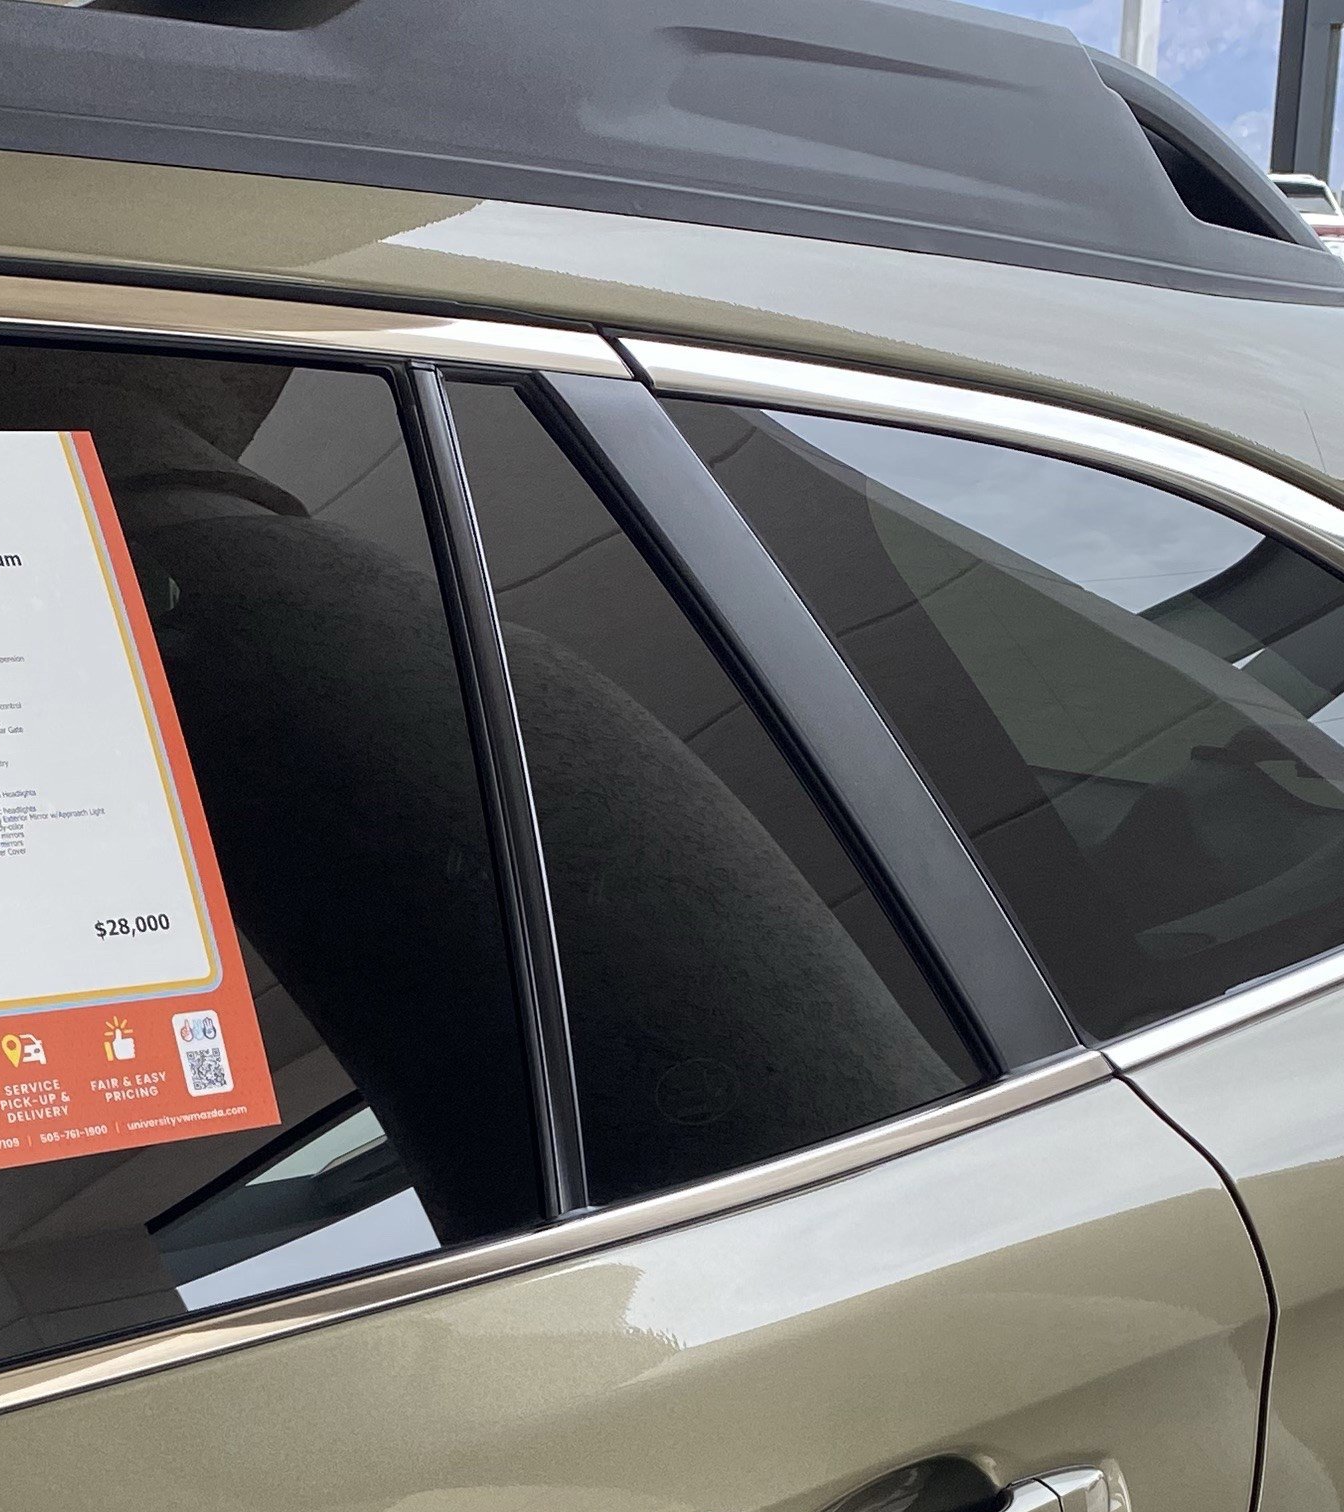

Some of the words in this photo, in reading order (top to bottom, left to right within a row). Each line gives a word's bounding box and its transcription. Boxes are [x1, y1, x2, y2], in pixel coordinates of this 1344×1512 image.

[94, 913, 170, 941] $28,000
[3, 1079, 60, 1096] SERVICE
[89, 1078, 118, 1091] FAIR
[134, 1071, 168, 1085] EASY
[0, 1093, 57, 1110] PICK-UP
[104, 1086, 158, 1102] PRICING
[6, 1105, 70, 1123] DELIVERY
[126, 1107, 248, 1132] universityvwmazda.com
